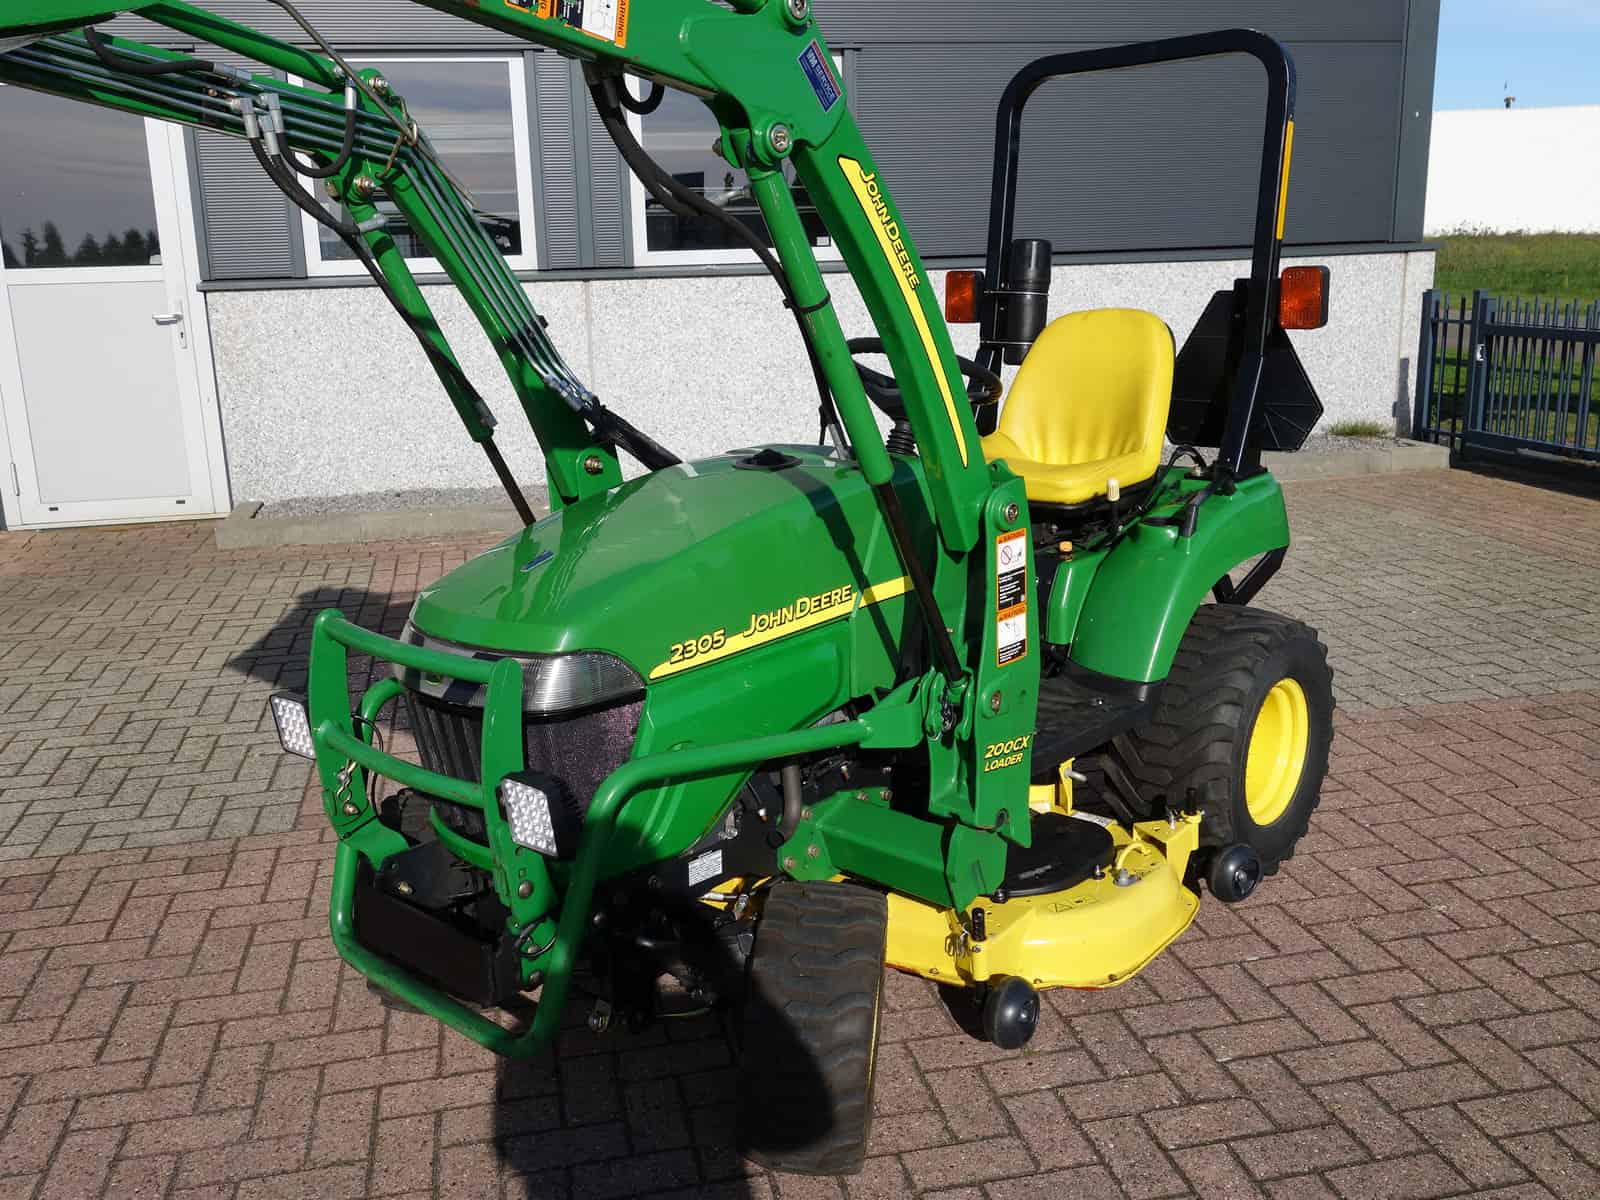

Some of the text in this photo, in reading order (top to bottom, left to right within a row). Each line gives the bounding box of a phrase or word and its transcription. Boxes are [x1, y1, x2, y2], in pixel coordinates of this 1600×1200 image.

[617, 0, 626, 37] ARNING
[860, 170, 920, 290] JOHN DEERE
[669, 584, 852, 663] 2305 JOHN DEERE
[984, 735, 1030, 759] 200CX
[984, 752, 1024, 772] LOADER
